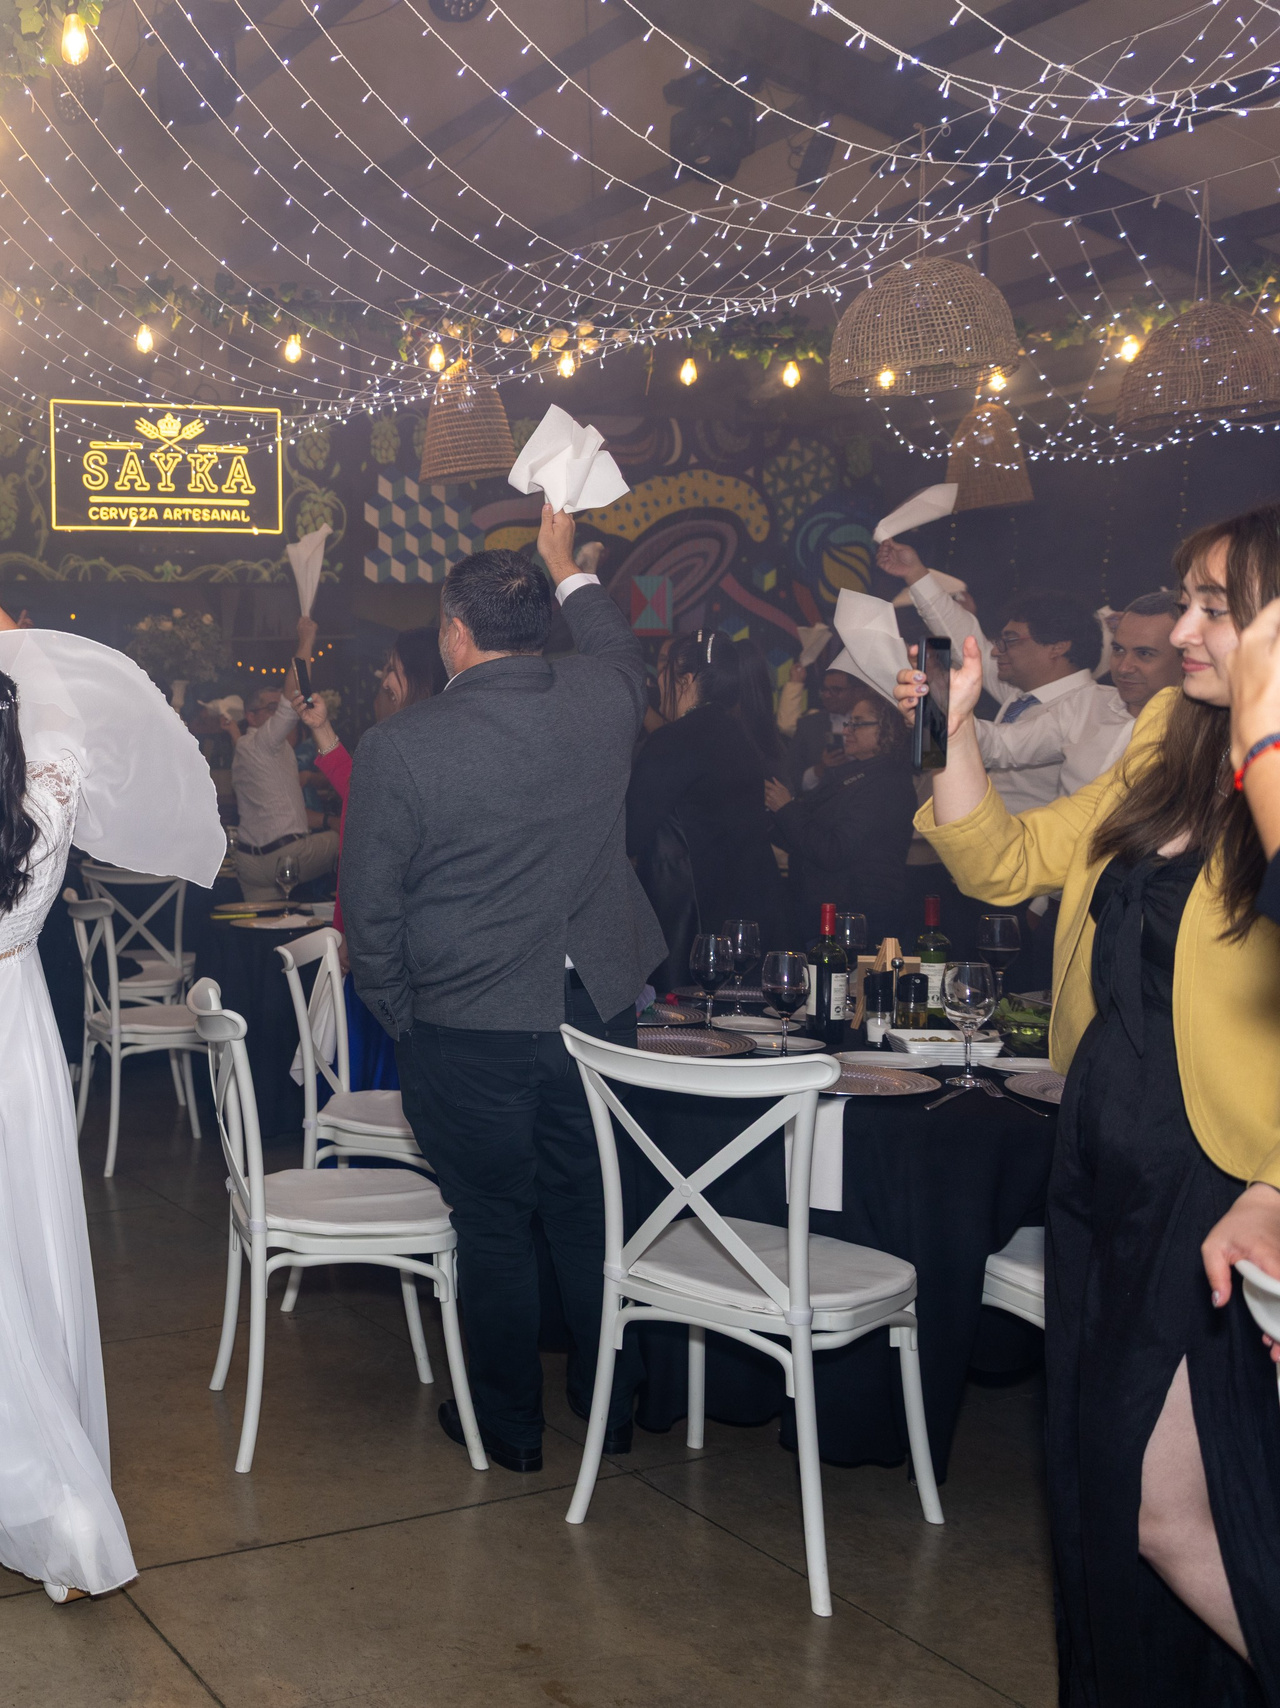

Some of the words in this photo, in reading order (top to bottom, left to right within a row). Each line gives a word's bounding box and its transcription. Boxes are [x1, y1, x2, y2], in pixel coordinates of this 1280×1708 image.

[82, 450, 256, 494] SAYKA
[88, 506, 159, 521] CERVEZA
[162, 507, 251, 523] ARTESANAL
